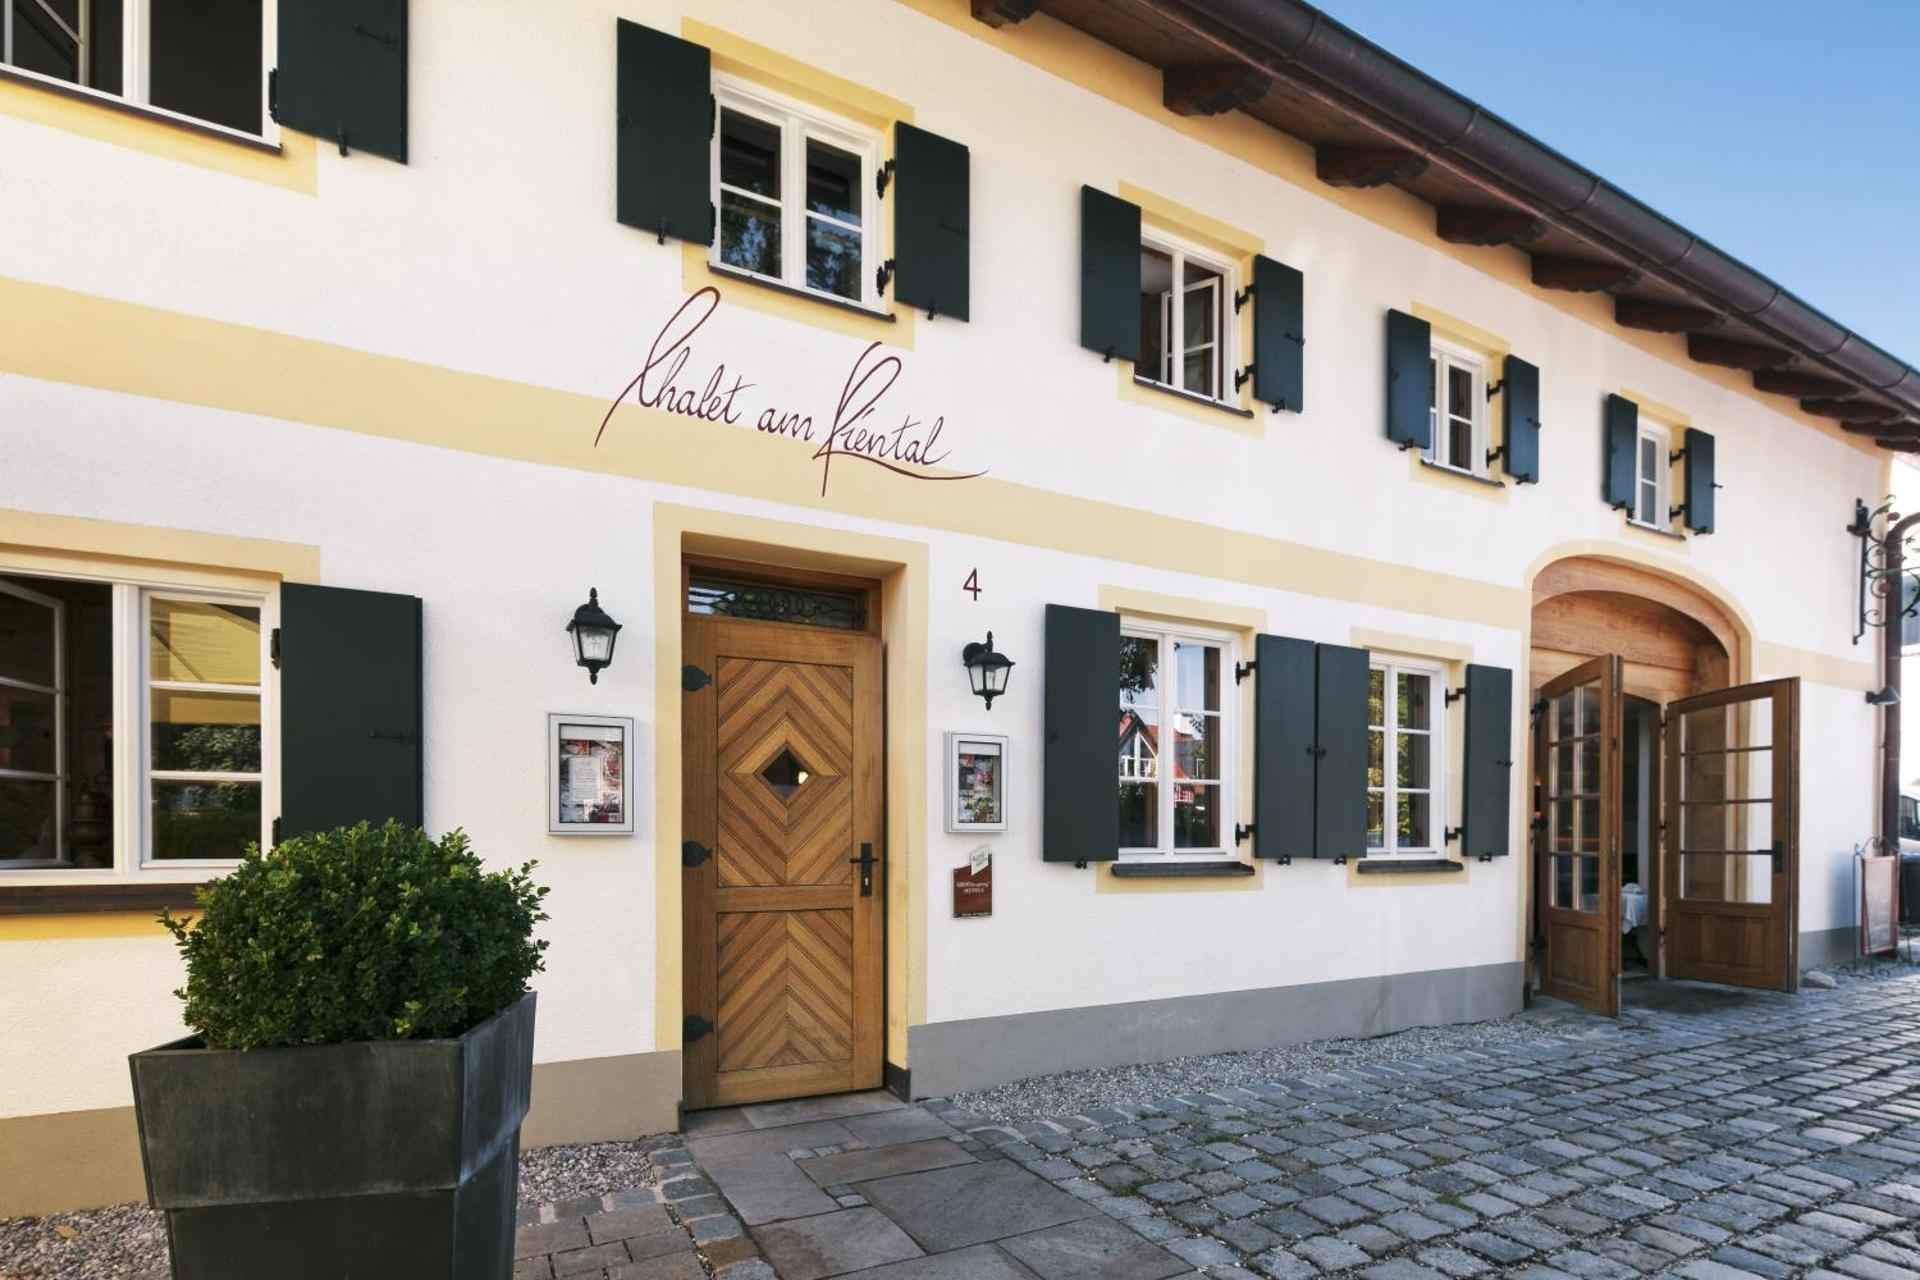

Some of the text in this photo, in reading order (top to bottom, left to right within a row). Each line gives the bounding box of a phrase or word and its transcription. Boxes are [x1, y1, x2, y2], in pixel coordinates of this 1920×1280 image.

[595, 286, 988, 497] Chalet am Kiental
[959, 568, 982, 602] 4
